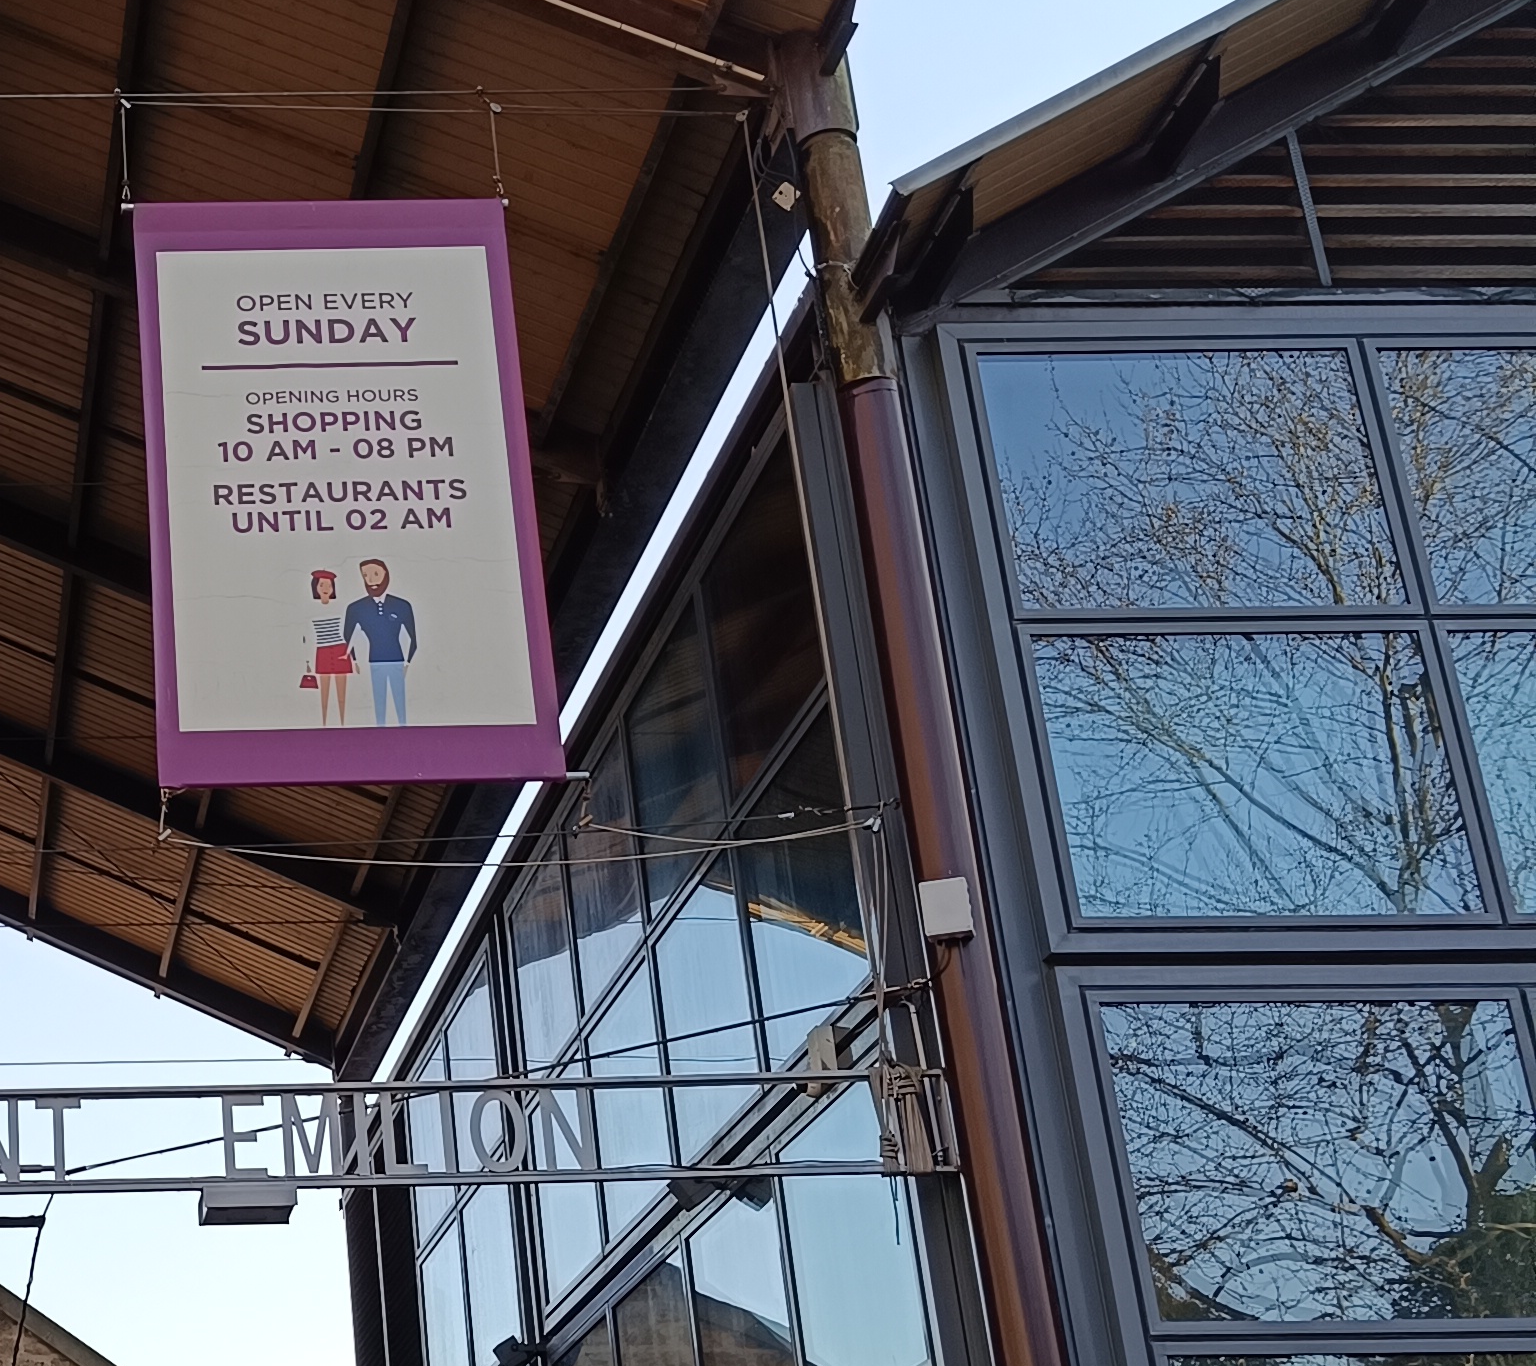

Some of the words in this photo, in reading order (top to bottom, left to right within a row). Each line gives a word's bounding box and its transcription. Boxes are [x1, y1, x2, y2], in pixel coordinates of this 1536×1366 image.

[236, 293, 313, 312] OPEN
[323, 291, 413, 310] EVERY
[237, 317, 417, 346] SUNDAY
[245, 390, 340, 406] OPENING
[346, 388, 419, 403] HOURS
[246, 410, 422, 435] SHOPPING
[217, 440, 254, 463] 10
[266, 439, 317, 462] AM
[352, 437, 395, 460] 08
[407, 436, 455, 459] PM
[213, 478, 467, 506] RESTAURANTS
[231, 509, 335, 534] UNTIL
[345, 508, 388, 531] 02
[400, 507, 452, 530] AM
[222, 1088, 597, 1178] EMILION
